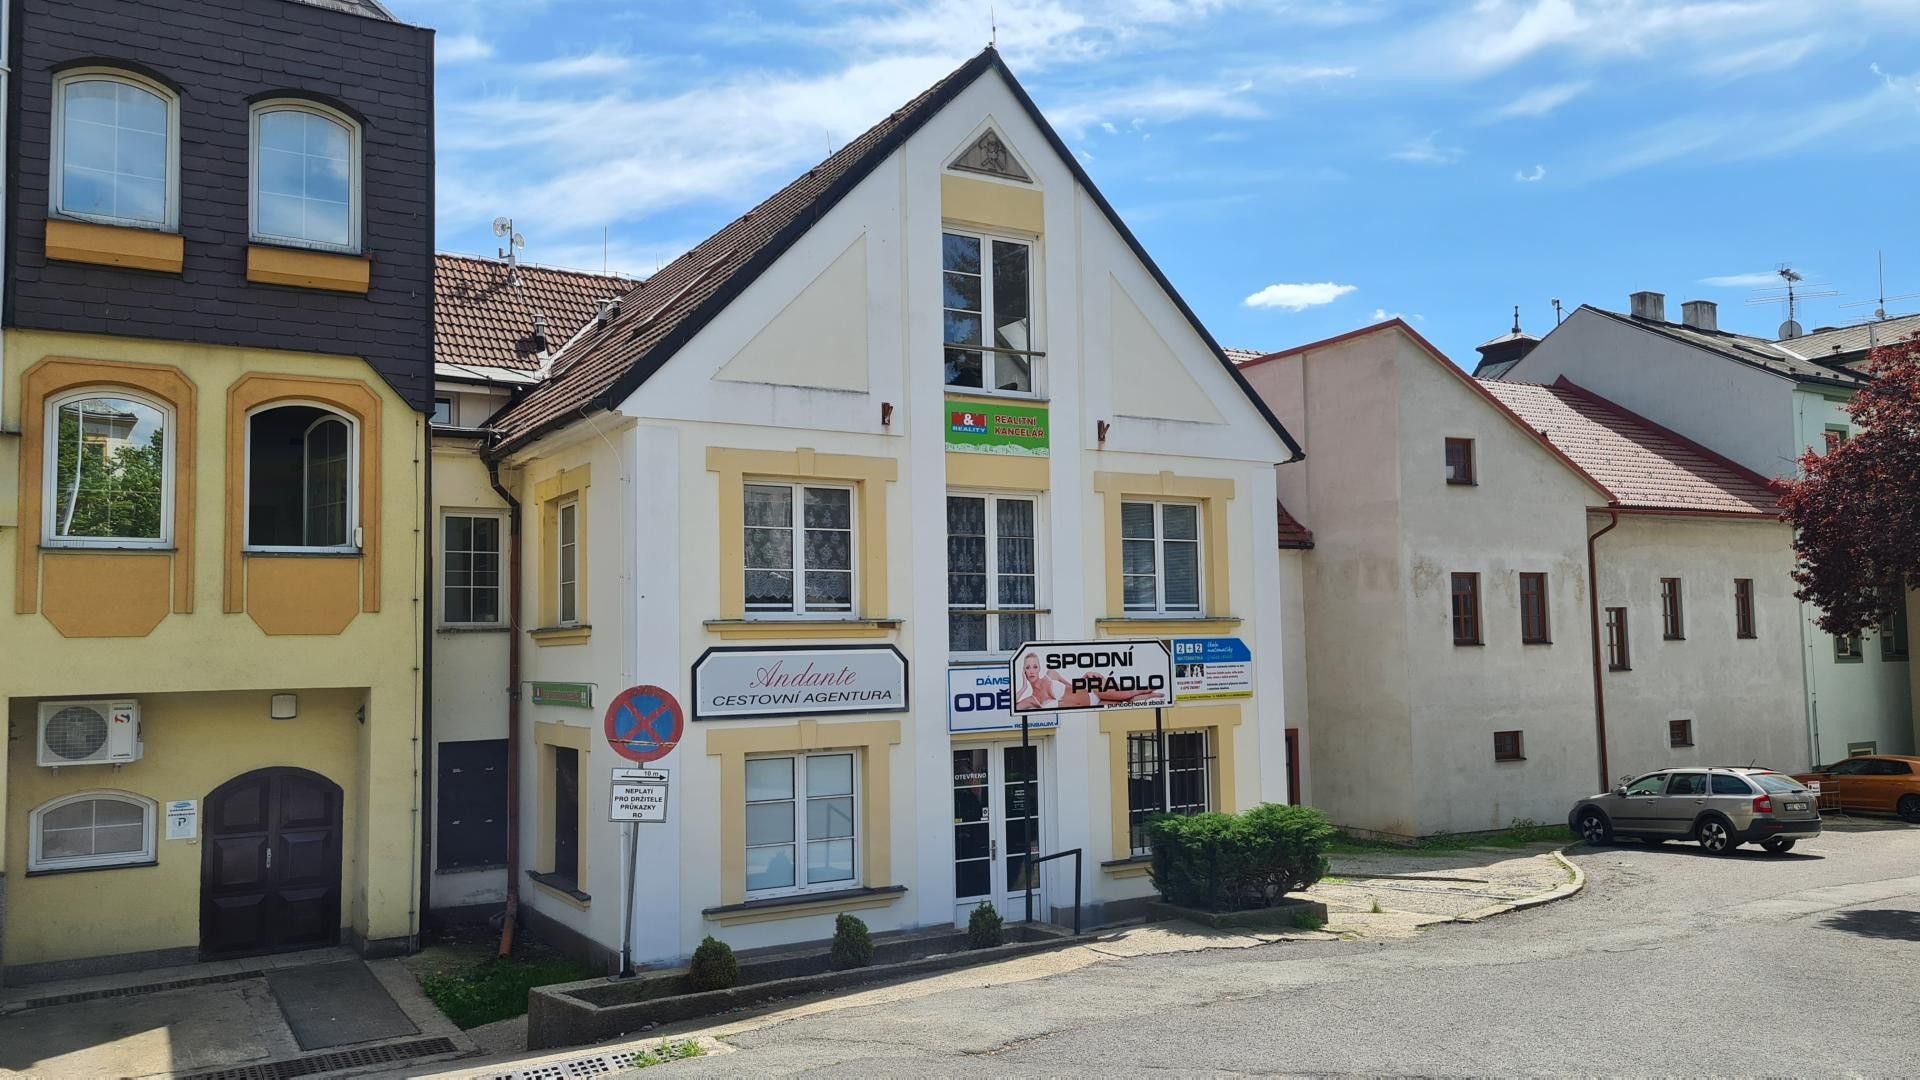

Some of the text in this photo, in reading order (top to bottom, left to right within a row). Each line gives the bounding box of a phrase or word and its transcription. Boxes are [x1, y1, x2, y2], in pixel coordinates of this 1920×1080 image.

[1046, 645, 1134, 669] SPODNÍ
[750, 660, 857, 688] Andante
[976, 675, 1009, 686] DÁMS
[1072, 671, 1164, 693] PRÁDLO
[712, 690, 892, 707] CESTOVNÍ AGENTURA
[954, 688, 1010, 712] ODĚ
[620, 802, 656, 811] PRŮKAZKY
